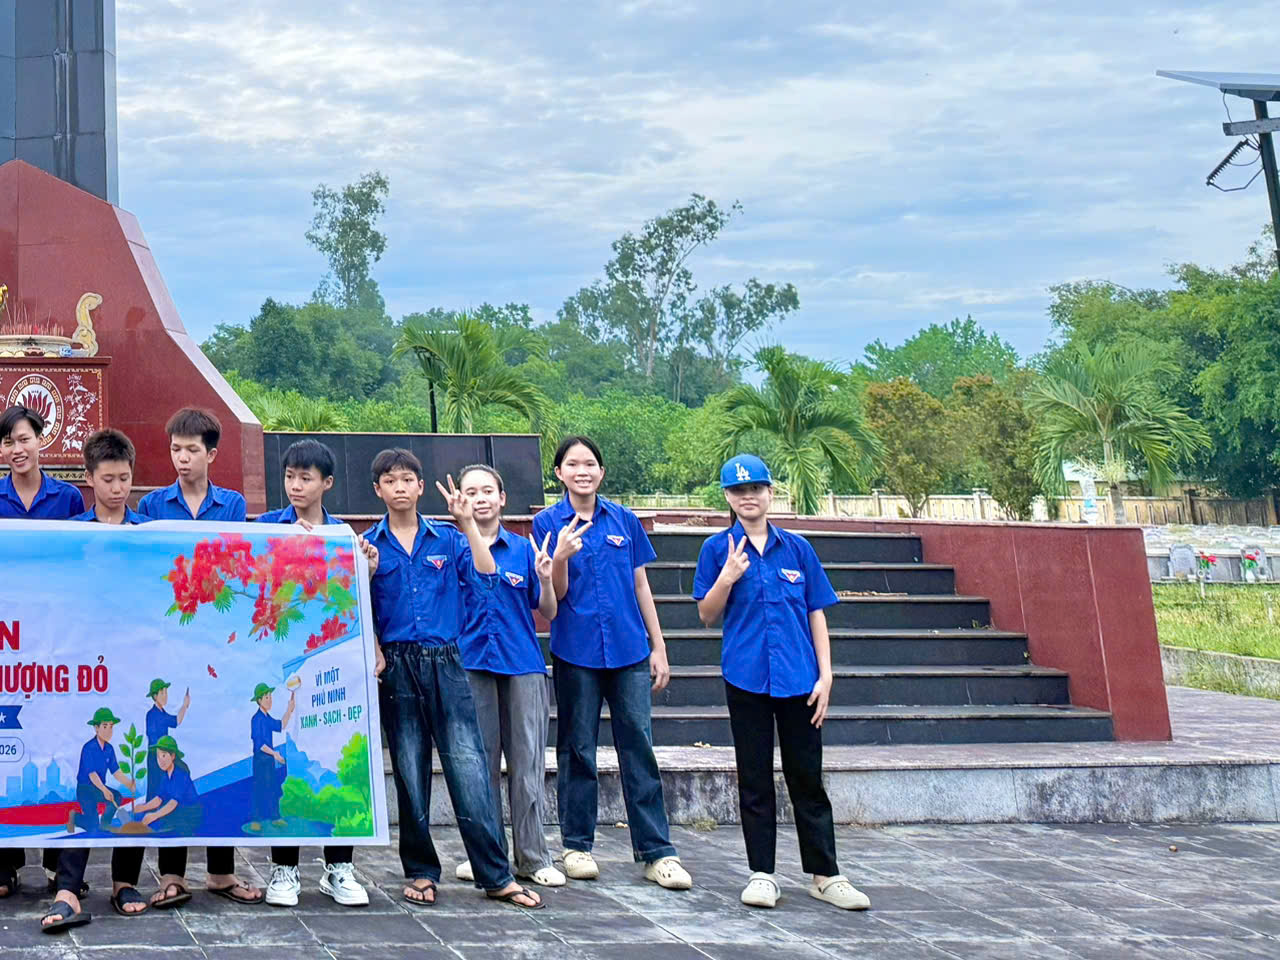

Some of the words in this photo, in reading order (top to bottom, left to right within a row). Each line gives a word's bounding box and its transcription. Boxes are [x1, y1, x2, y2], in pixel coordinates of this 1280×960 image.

[735, 462, 751, 481] LA
[77, 655, 108, 693] ĐỎ
[315, 670, 323, 686] VÌ
[323, 667, 340, 686] MỘT
[328, 686, 346, 704] NINH
[323, 708, 342, 727] SẠCH
